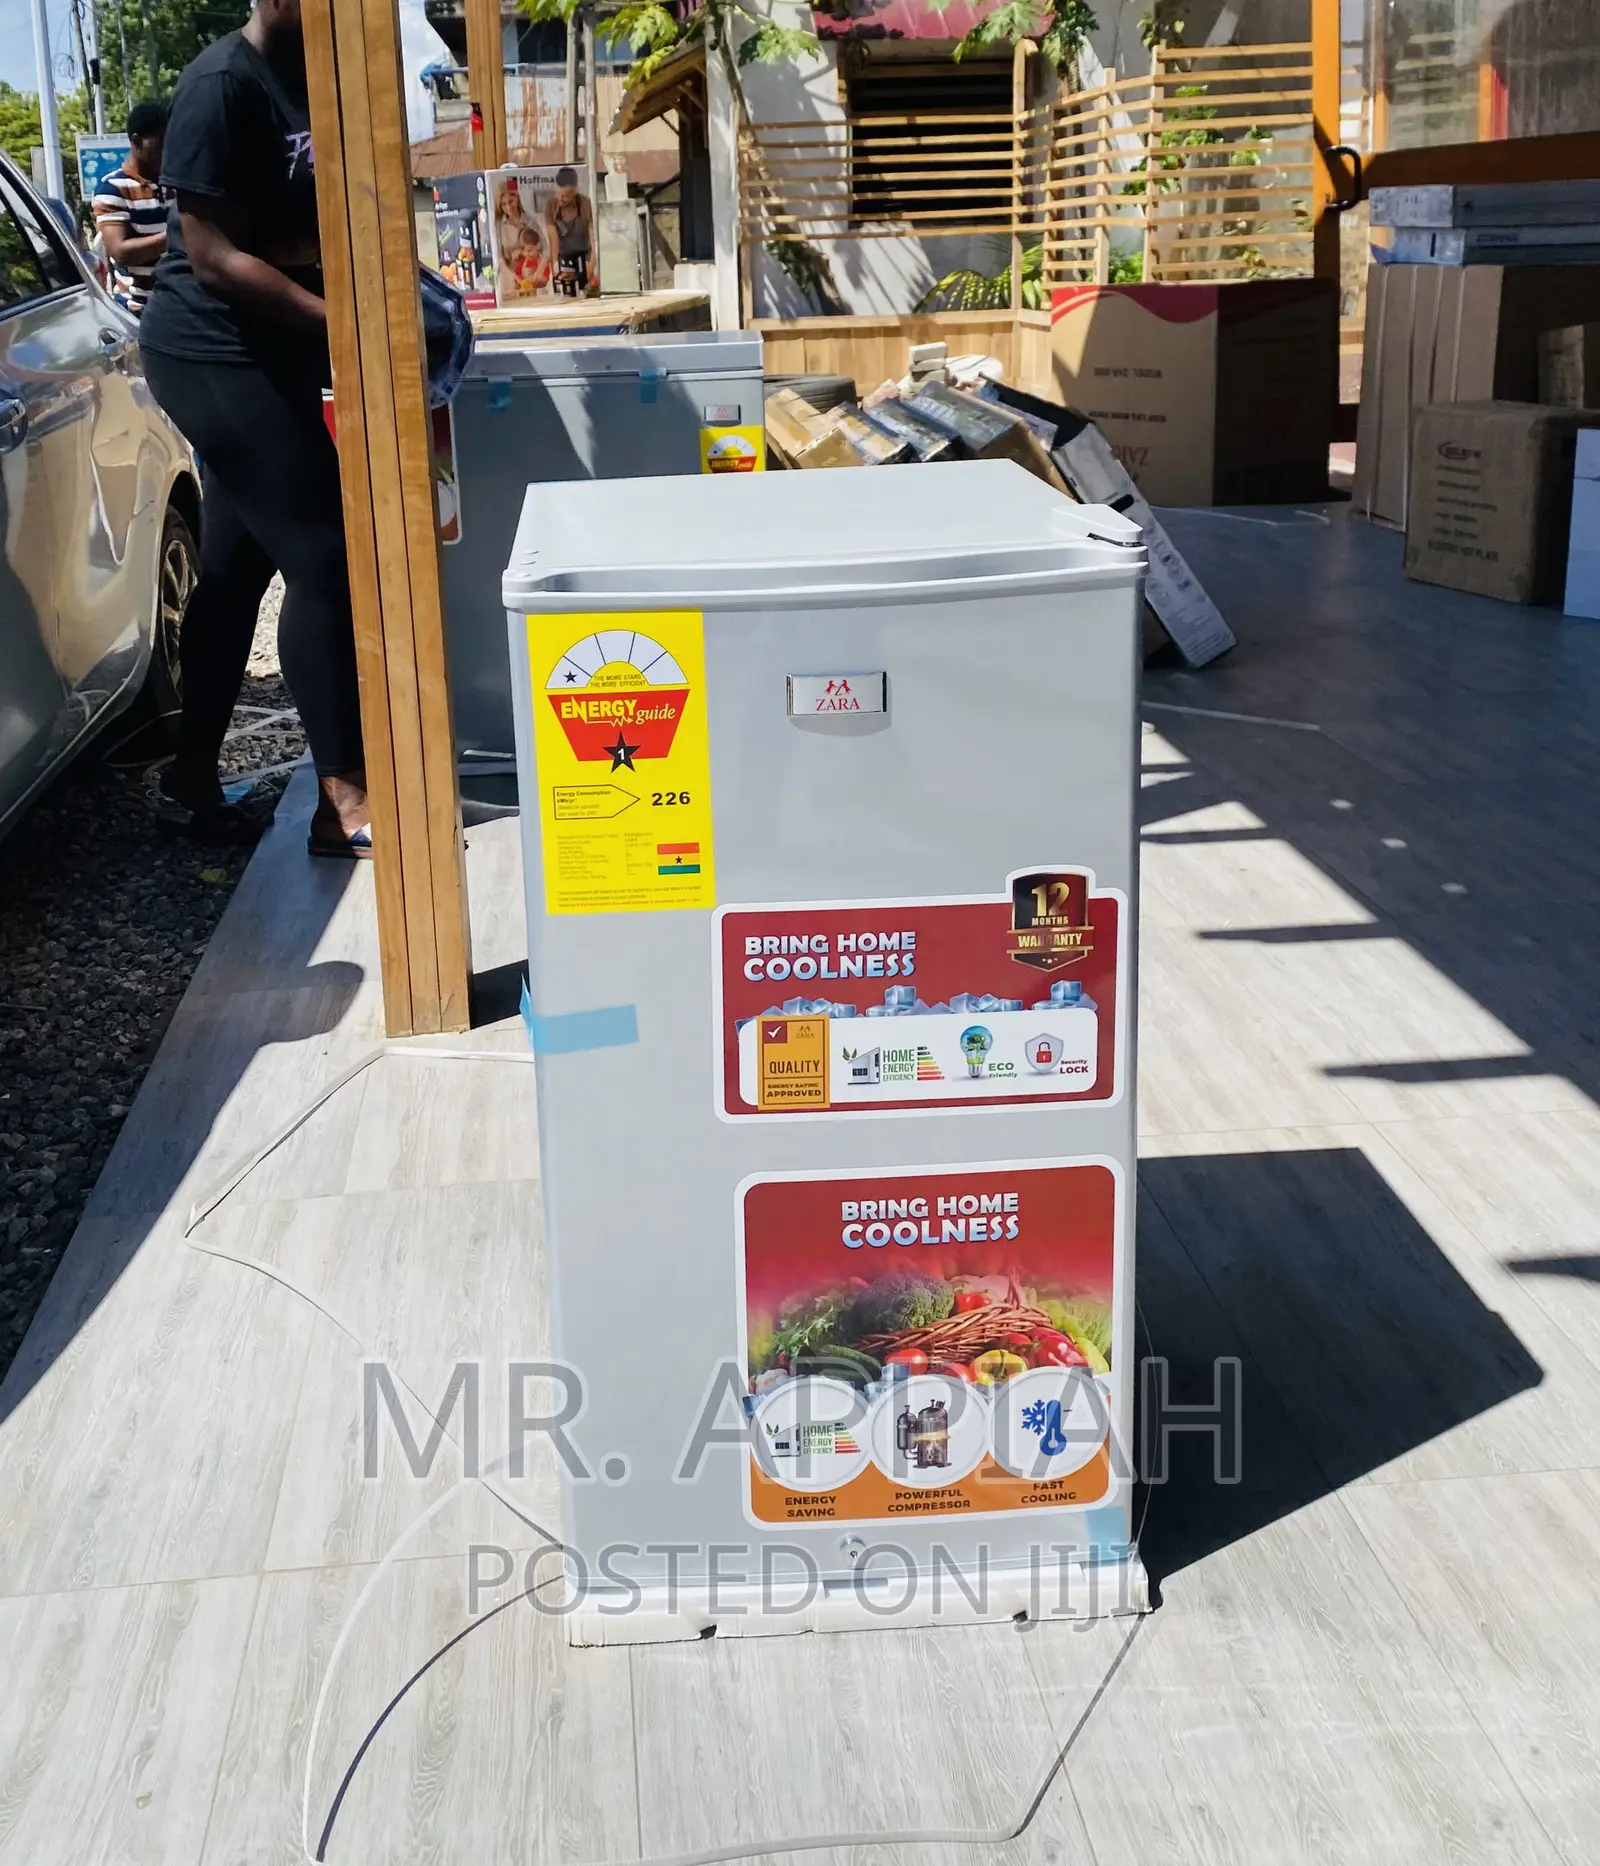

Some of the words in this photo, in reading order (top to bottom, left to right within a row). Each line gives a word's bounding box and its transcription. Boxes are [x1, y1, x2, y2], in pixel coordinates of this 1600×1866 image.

[624, 673, 642, 681] STARS
[560, 696, 638, 724] ENERGY
[635, 703, 676, 725] guide
[816, 697, 860, 712] ZARA
[617, 748, 625, 761] 1
[651, 791, 691, 806] 226
[1031, 881, 1070, 917] 12
[1031, 916, 1069, 926] MONTHS
[745, 933, 829, 956] BRING
[837, 931, 917, 953] HOME
[743, 952, 917, 982] COOLNESS
[883, 1049, 915, 1063] HOME
[769, 1059, 821, 1074] QUALITY
[883, 1063, 915, 1074] ENERGY
[988, 1062, 1014, 1072] ECO
[1060, 1065, 1089, 1074] LOCK
[883, 1073, 915, 1081] EFFICIENCY
[766, 1089, 822, 1098] APPROVED
[841, 1197, 930, 1221] BRING
[937, 1192, 1020, 1217] HOME
[841, 1214, 1020, 1249] COOLNESS
[803, 1425, 833, 1438] HOME
[803, 1438, 833, 1448] ENERGY
[1033, 1480, 1065, 1491] FAST
[785, 1495, 837, 1506] ENERGY
[895, 1489, 963, 1500] POWERFUL
[1021, 1492, 1077, 1504] COOLING
[887, 1500, 971, 1513] COMPRESSOR
[787, 1508, 836, 1518] SAVING
